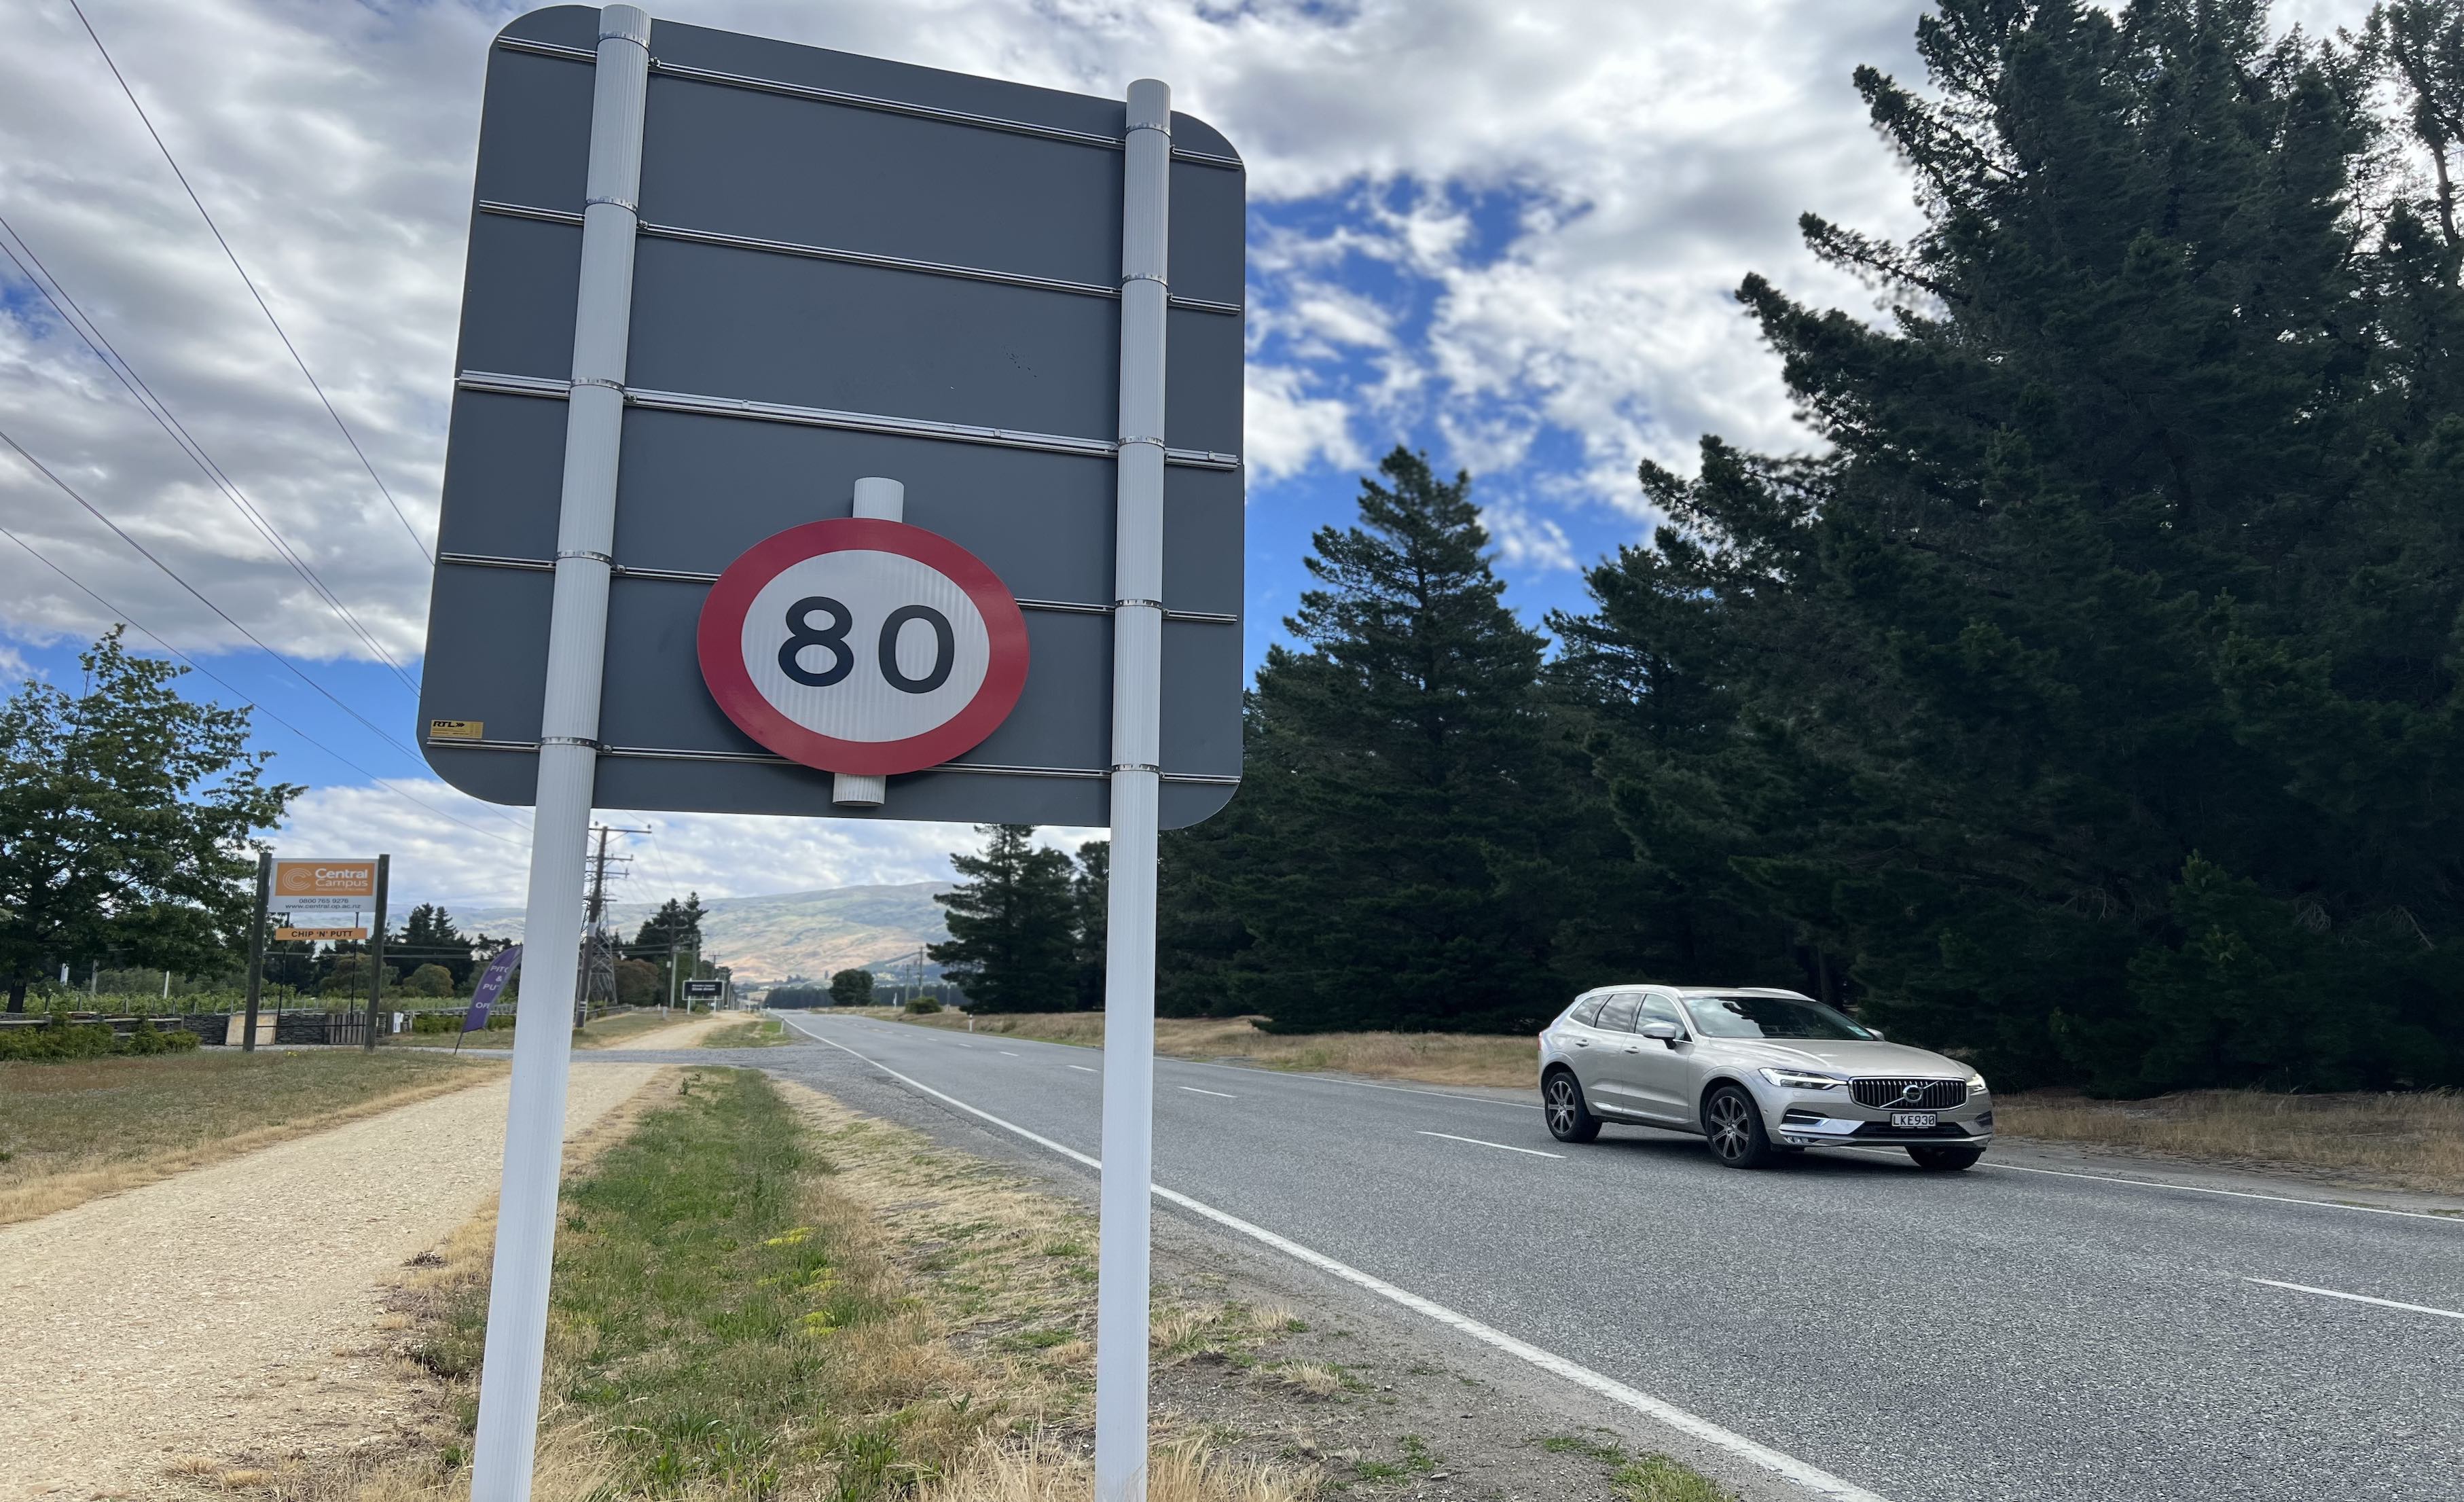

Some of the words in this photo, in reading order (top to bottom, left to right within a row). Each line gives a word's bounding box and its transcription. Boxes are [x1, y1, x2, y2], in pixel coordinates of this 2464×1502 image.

[778, 596, 954, 694] 80
[315, 868, 368, 879] Central
[315, 878, 368, 888] Campus
[1894, 1115, 1935, 1126] LKE930
